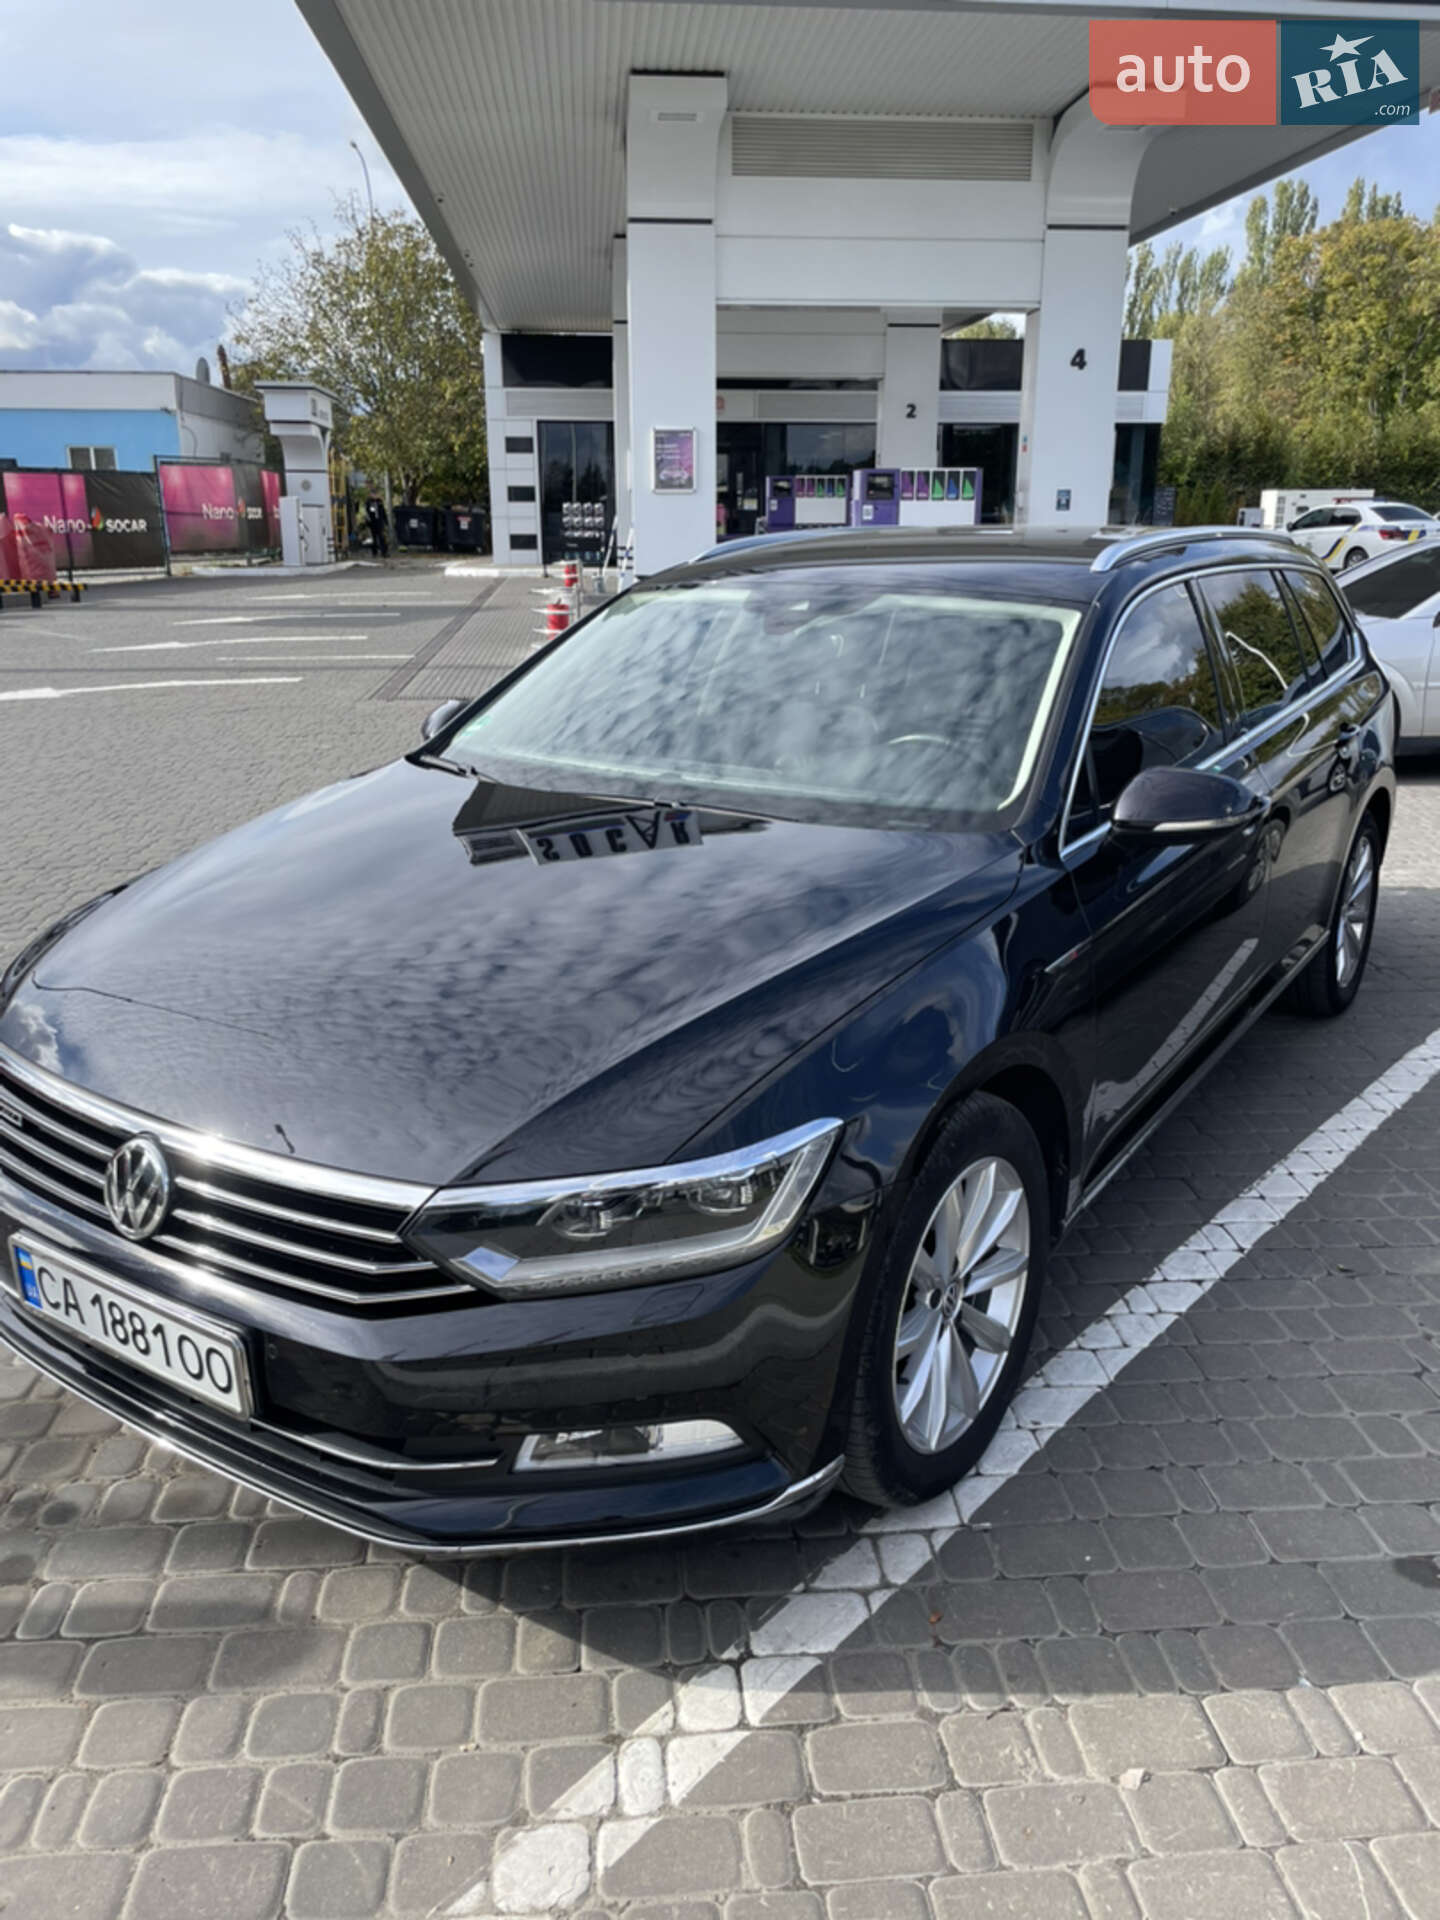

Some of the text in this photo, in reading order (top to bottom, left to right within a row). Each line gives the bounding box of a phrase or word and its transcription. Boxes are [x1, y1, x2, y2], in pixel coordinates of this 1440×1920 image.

[1070, 348, 1087, 370] 4
[905, 403, 917, 419] 2
[43, 515, 147, 533] Nano SOCAR
[38, 1266, 85, 1325] CA
